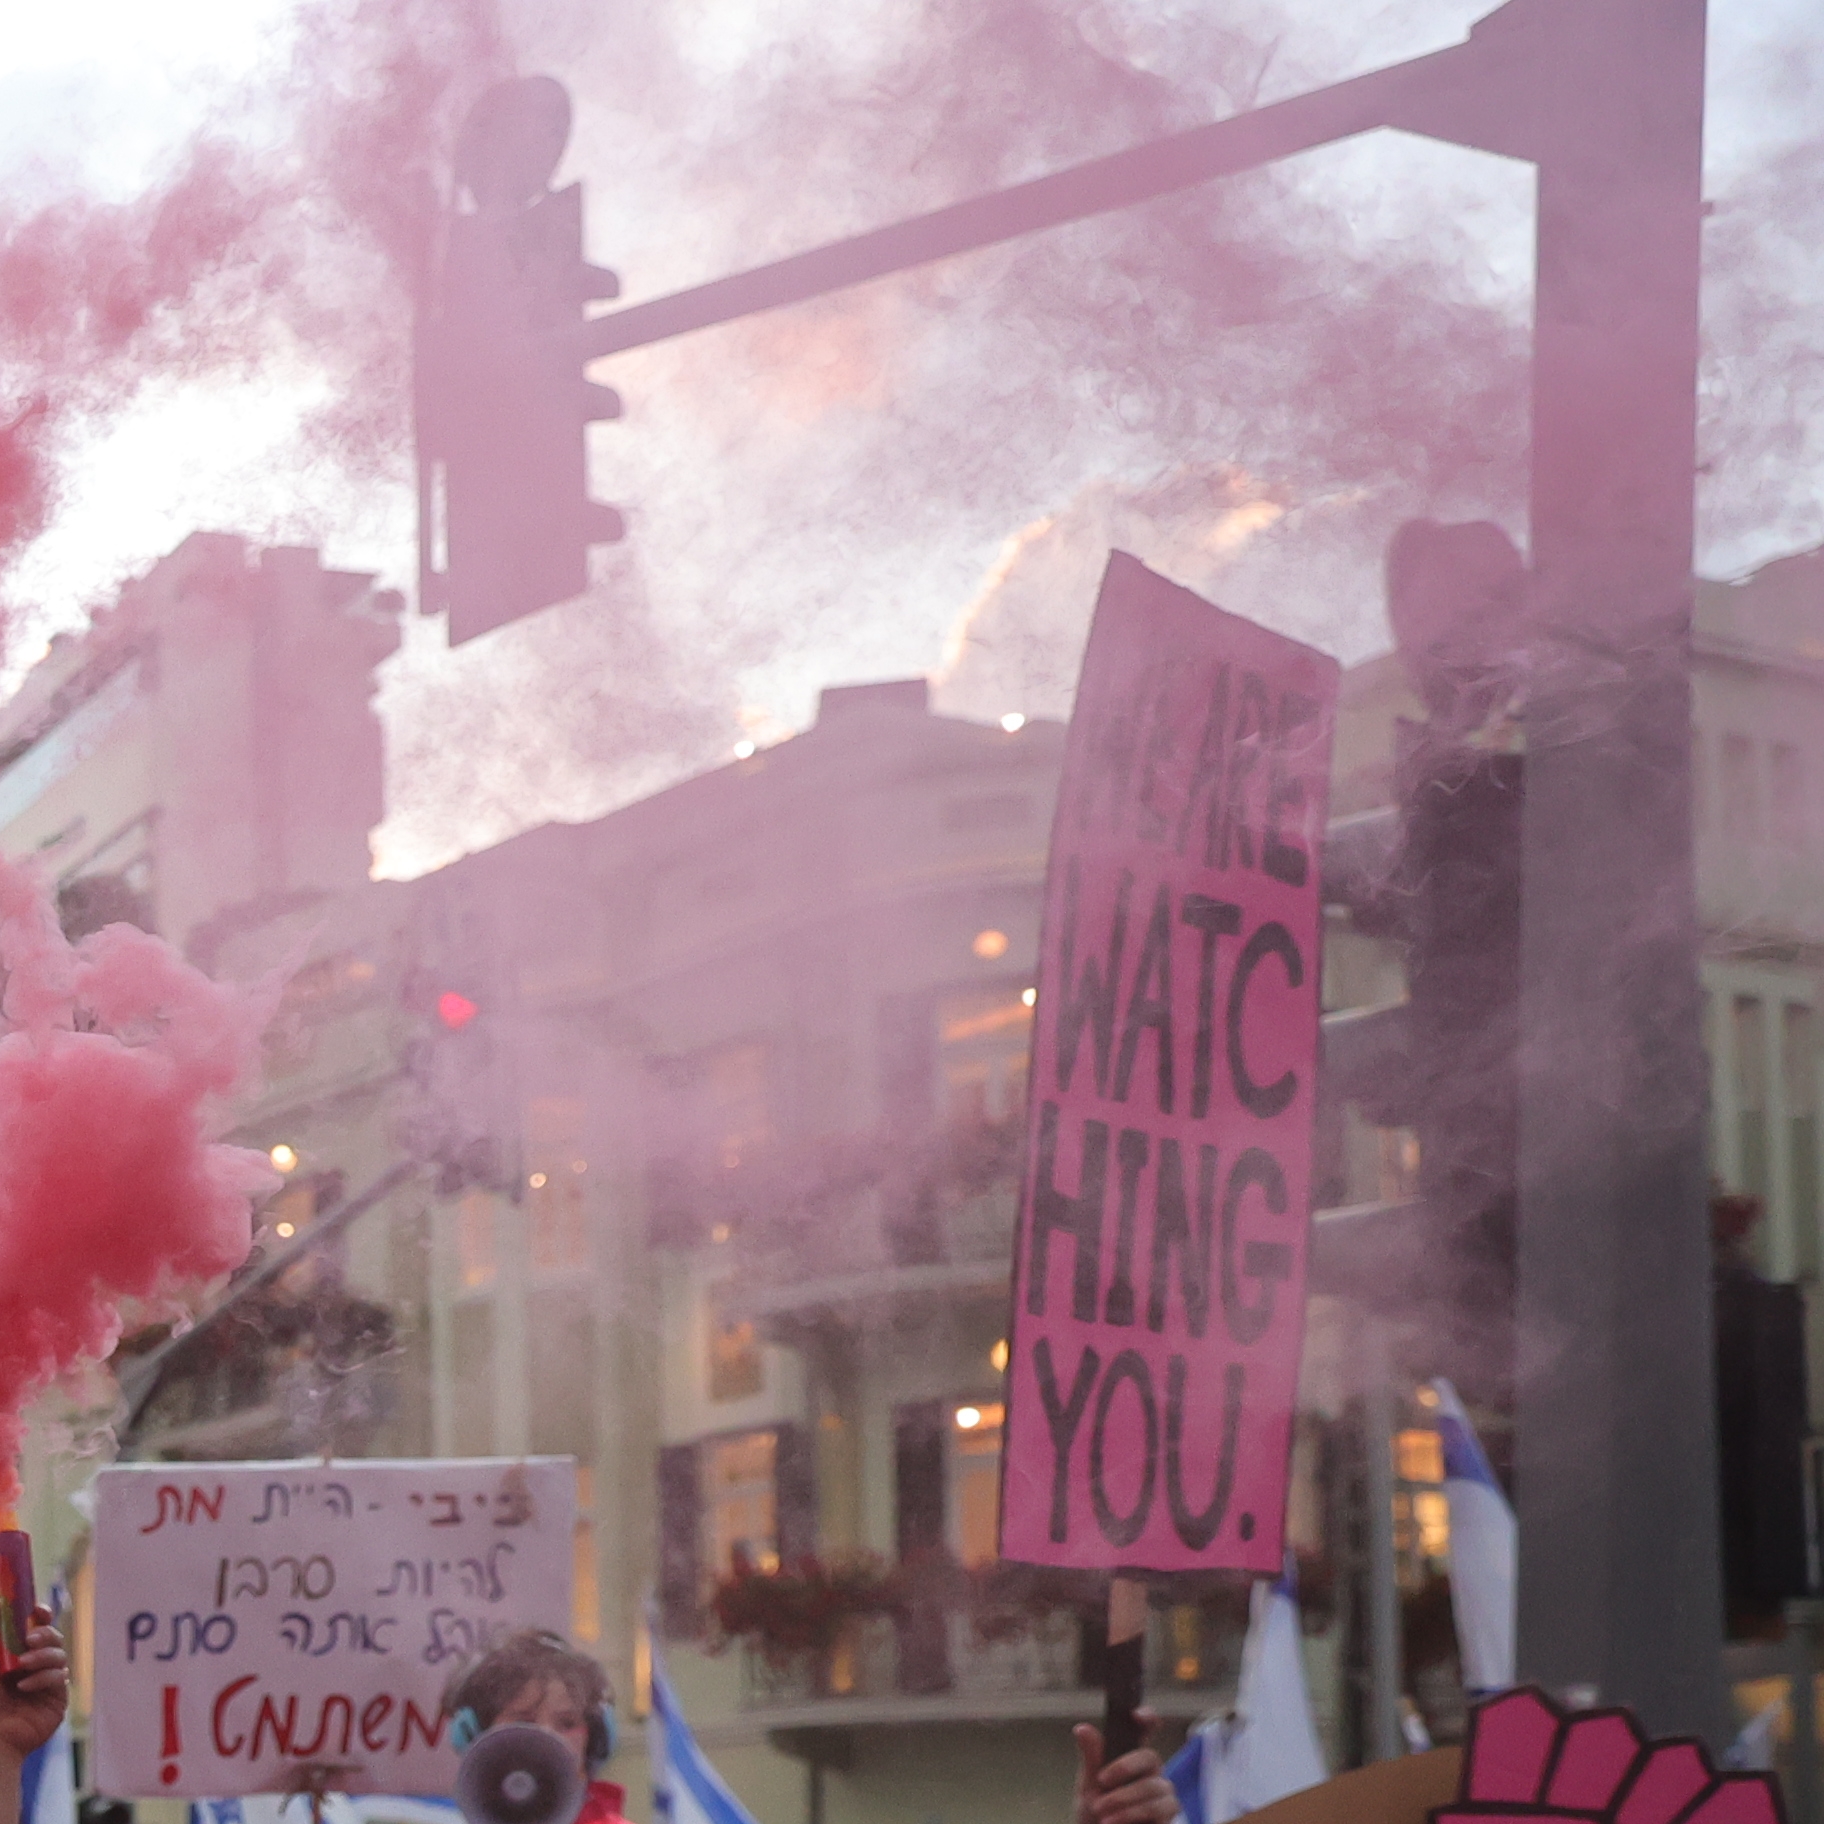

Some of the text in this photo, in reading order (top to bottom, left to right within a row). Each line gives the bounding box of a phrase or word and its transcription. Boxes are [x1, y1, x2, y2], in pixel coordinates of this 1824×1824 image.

[1057, 853, 1304, 1120] WATC
[1026, 1100, 1296, 1347] HING
[1030, 1337, 1257, 1551] YOU.
[140, 1484, 226, 1534] מת
[214, 1542, 515, 1608] להיות סרבן
[126, 1611, 238, 1662] סתם
[280, 1611, 399, 1657] אתה
